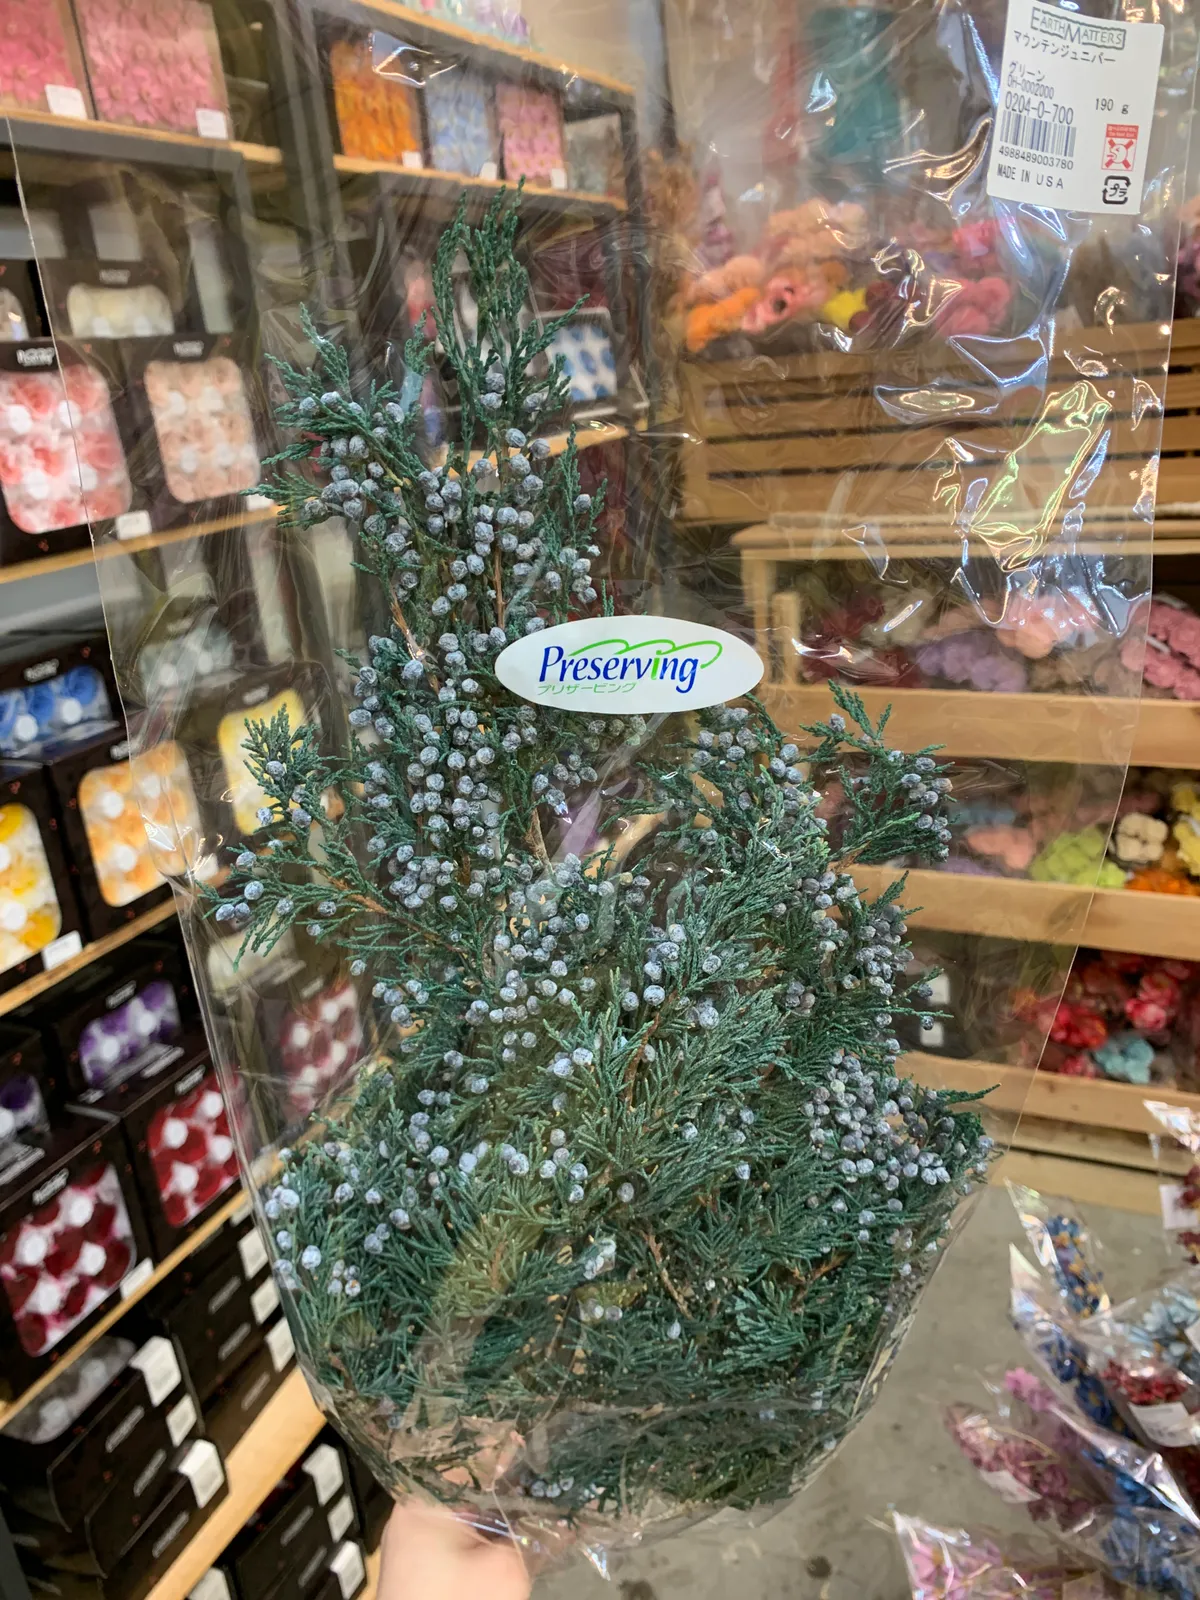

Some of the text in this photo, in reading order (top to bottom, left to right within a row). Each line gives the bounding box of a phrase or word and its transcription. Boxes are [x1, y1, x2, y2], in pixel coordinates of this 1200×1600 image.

[1009, 61, 1045, 82] グリーン
[1005, 91, 1074, 125] 0204-0-700
[1095, 98, 1114, 112] 190
[998, 145, 1074, 170] 4988489003780
[997, 163, 1017, 180] MADE
[1021, 169, 1031, 183] IN
[1109, 183, 1128, 197] プラ
[538, 645, 700, 694] Preserving
